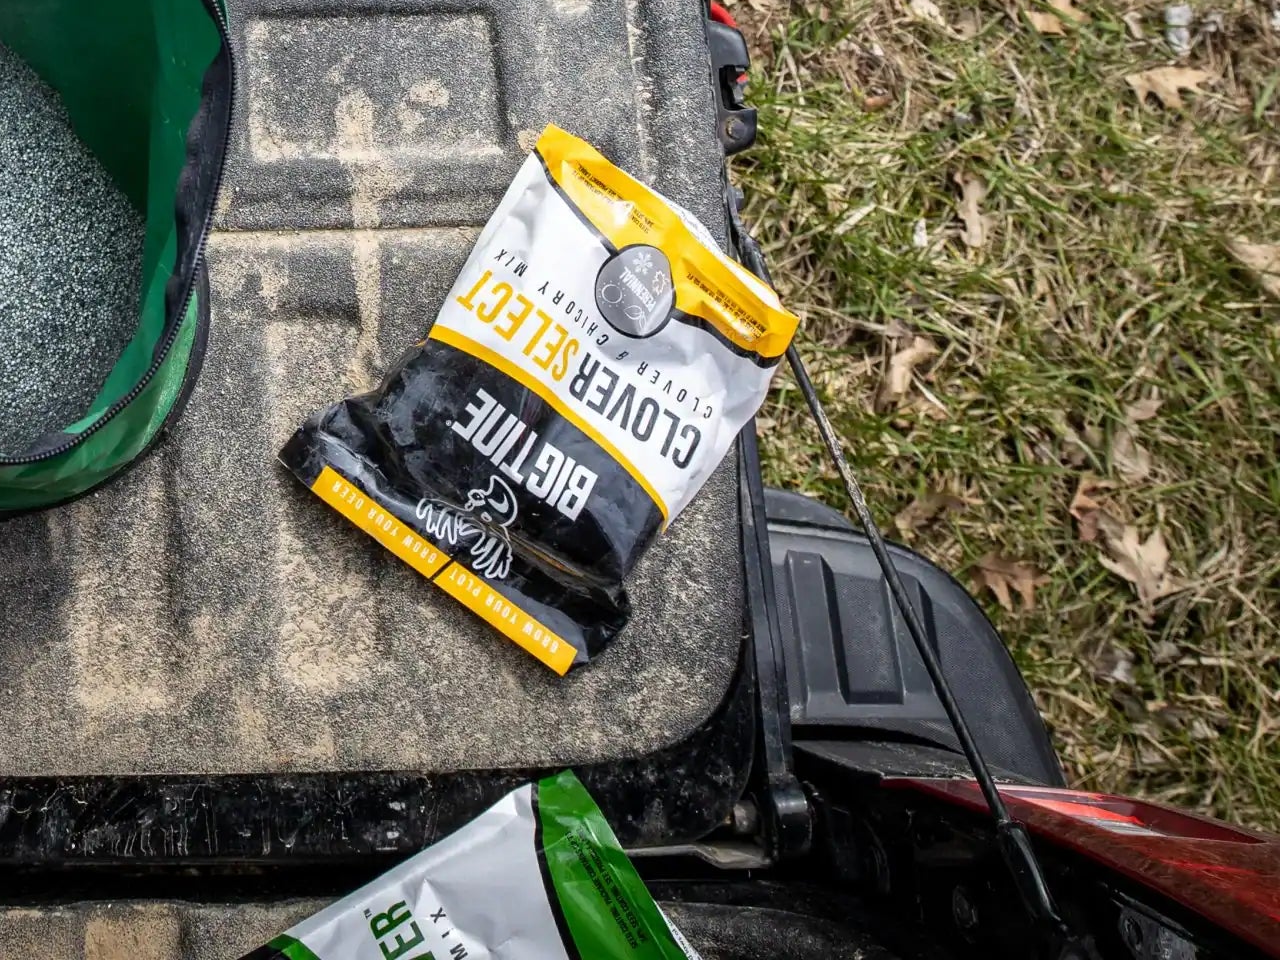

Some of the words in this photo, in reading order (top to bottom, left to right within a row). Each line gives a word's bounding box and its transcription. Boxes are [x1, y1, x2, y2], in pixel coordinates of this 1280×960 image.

[494, 248, 530, 277] MIX
[619, 266, 658, 313] PERENNIAL
[456, 269, 580, 382] SELECT
[537, 280, 609, 347] CHICORY
[615, 349, 631, 363] &
[636, 360, 713, 420] CLOVER
[568, 351, 702, 470] CLOVER
[331, 479, 363, 510] DEER
[367, 508, 400, 538] YOUR
[401, 534, 439, 564] GROW
[448, 566, 482, 597] PLOT
[484, 595, 519, 625] YOUR
[521, 623, 560, 655] GROW
[429, 906, 468, 960] MIX
